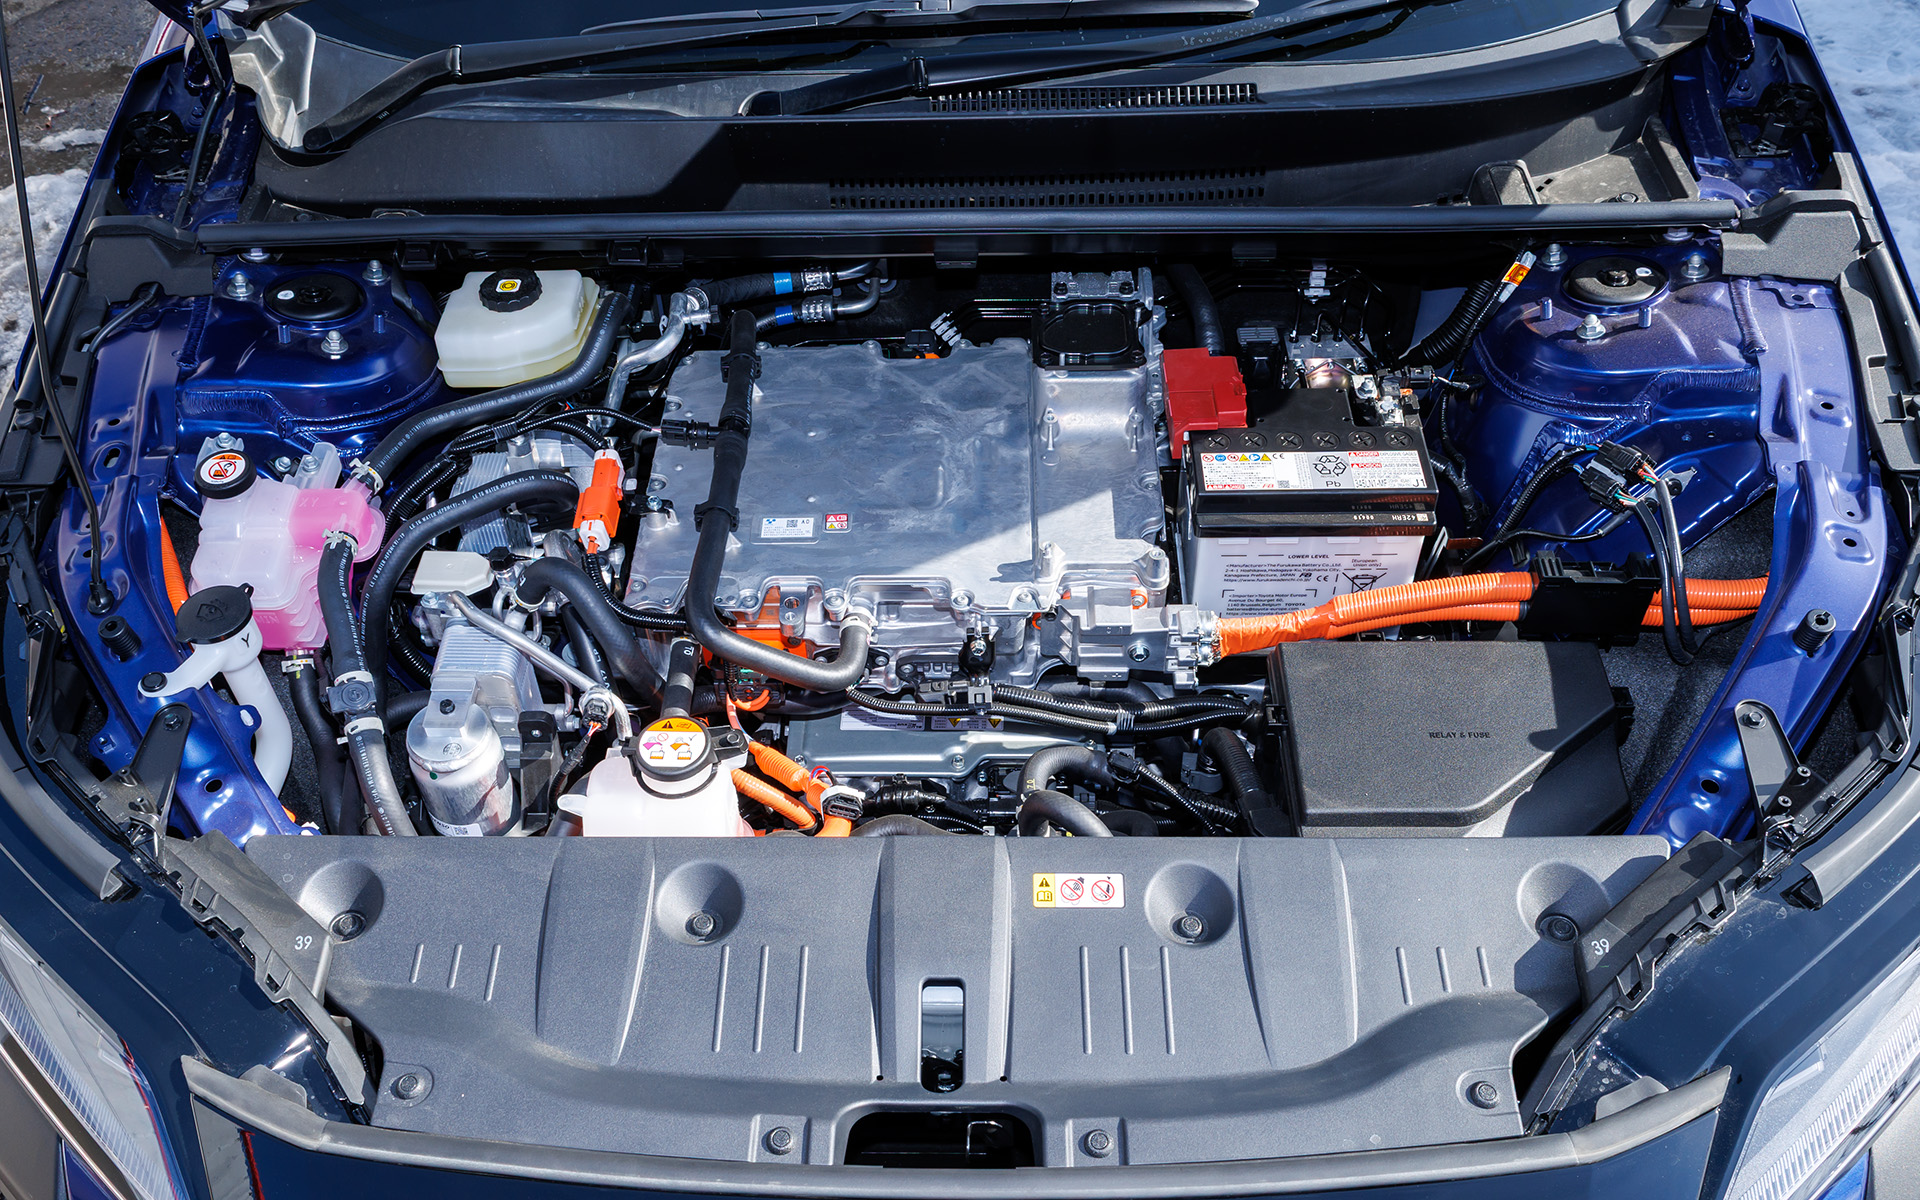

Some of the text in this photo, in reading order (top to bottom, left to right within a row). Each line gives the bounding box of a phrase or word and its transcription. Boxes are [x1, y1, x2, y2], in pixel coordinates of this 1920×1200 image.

[485, 485, 499, 494] WATER
[1413, 479, 1425, 487] J1
[422, 512, 436, 521] WATER
[376, 560, 386, 574] WATER
[241, 632, 250, 648] Y
[361, 753, 369, 767] WATER
[295, 935, 312, 950] 39
[1591, 939, 1610, 955] 39
